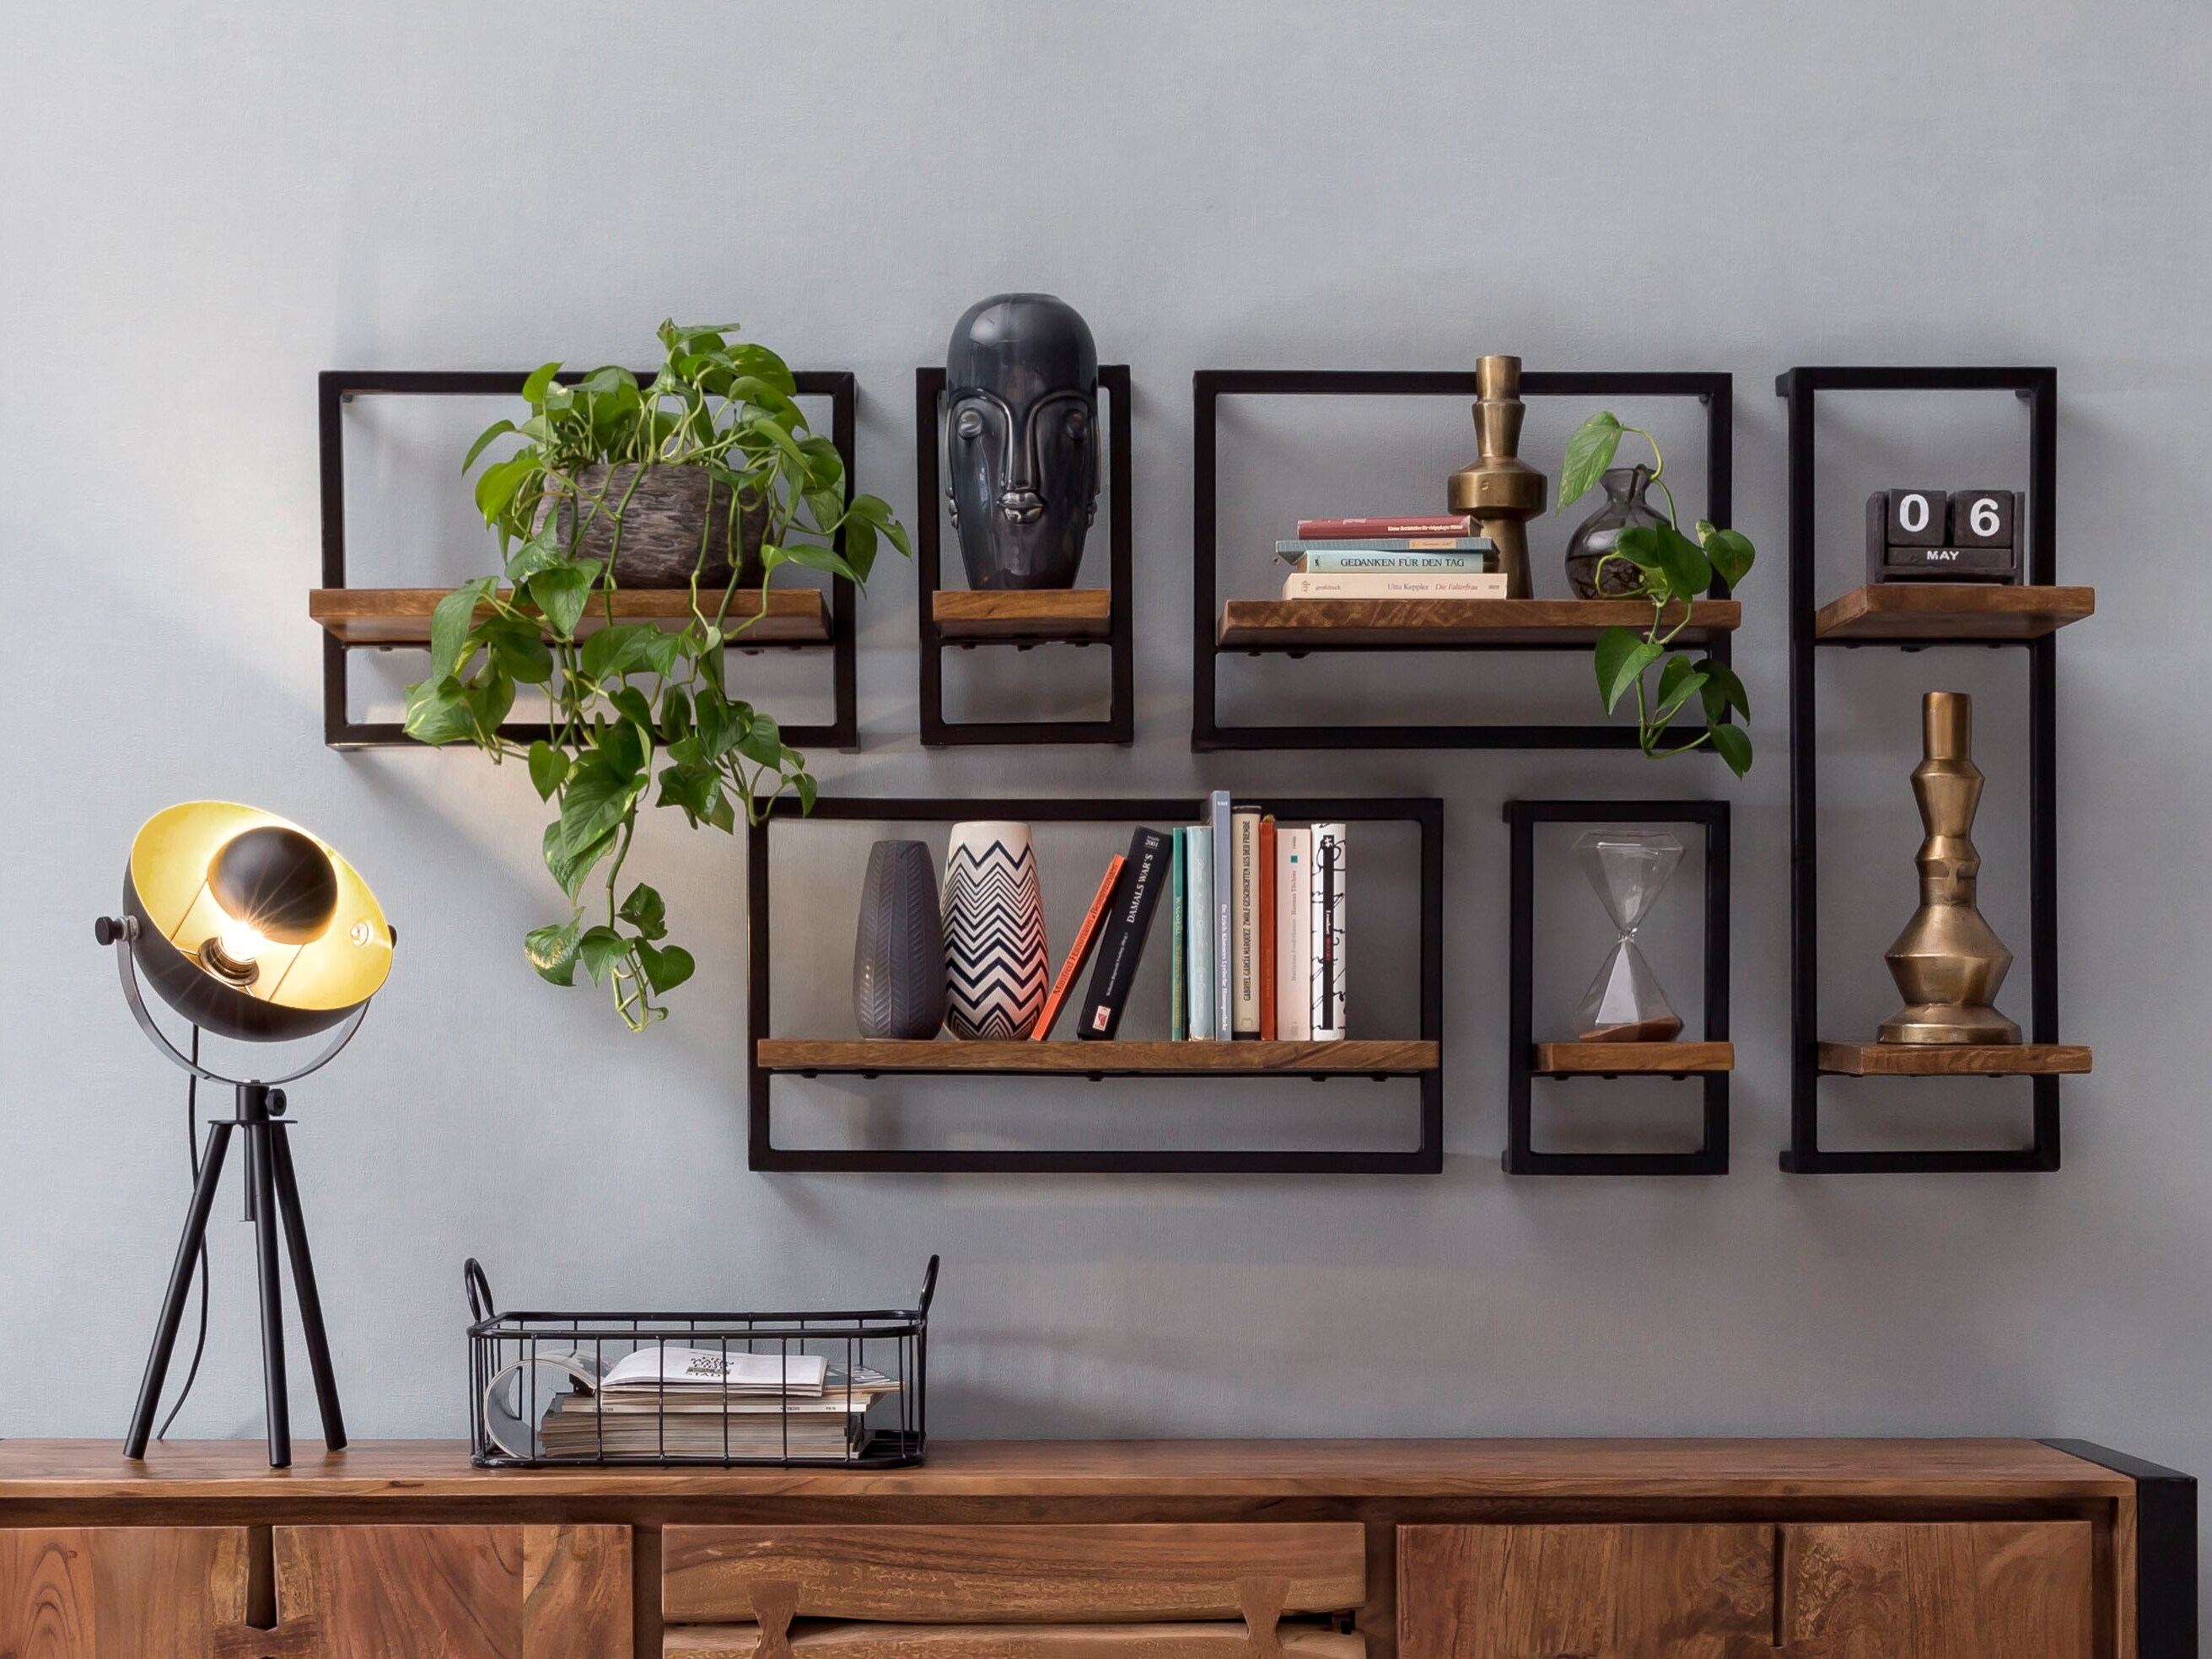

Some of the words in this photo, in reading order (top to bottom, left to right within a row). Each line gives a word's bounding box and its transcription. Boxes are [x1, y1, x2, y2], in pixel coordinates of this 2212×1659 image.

[1899, 494, 1929, 532] 0
[1970, 498, 2000, 537] 6
[1927, 550, 1960, 561] MAY
[1340, 557, 1394, 567] GEDANKEN
[1398, 556, 1419, 567] FÜR
[1422, 557, 1443, 567] DEN
[1445, 557, 1465, 567] TAG
[1403, 583, 1429, 592] Keppler
[1127, 883, 1144, 924] DAMALS
[1138, 854, 1154, 883] WAR'S
